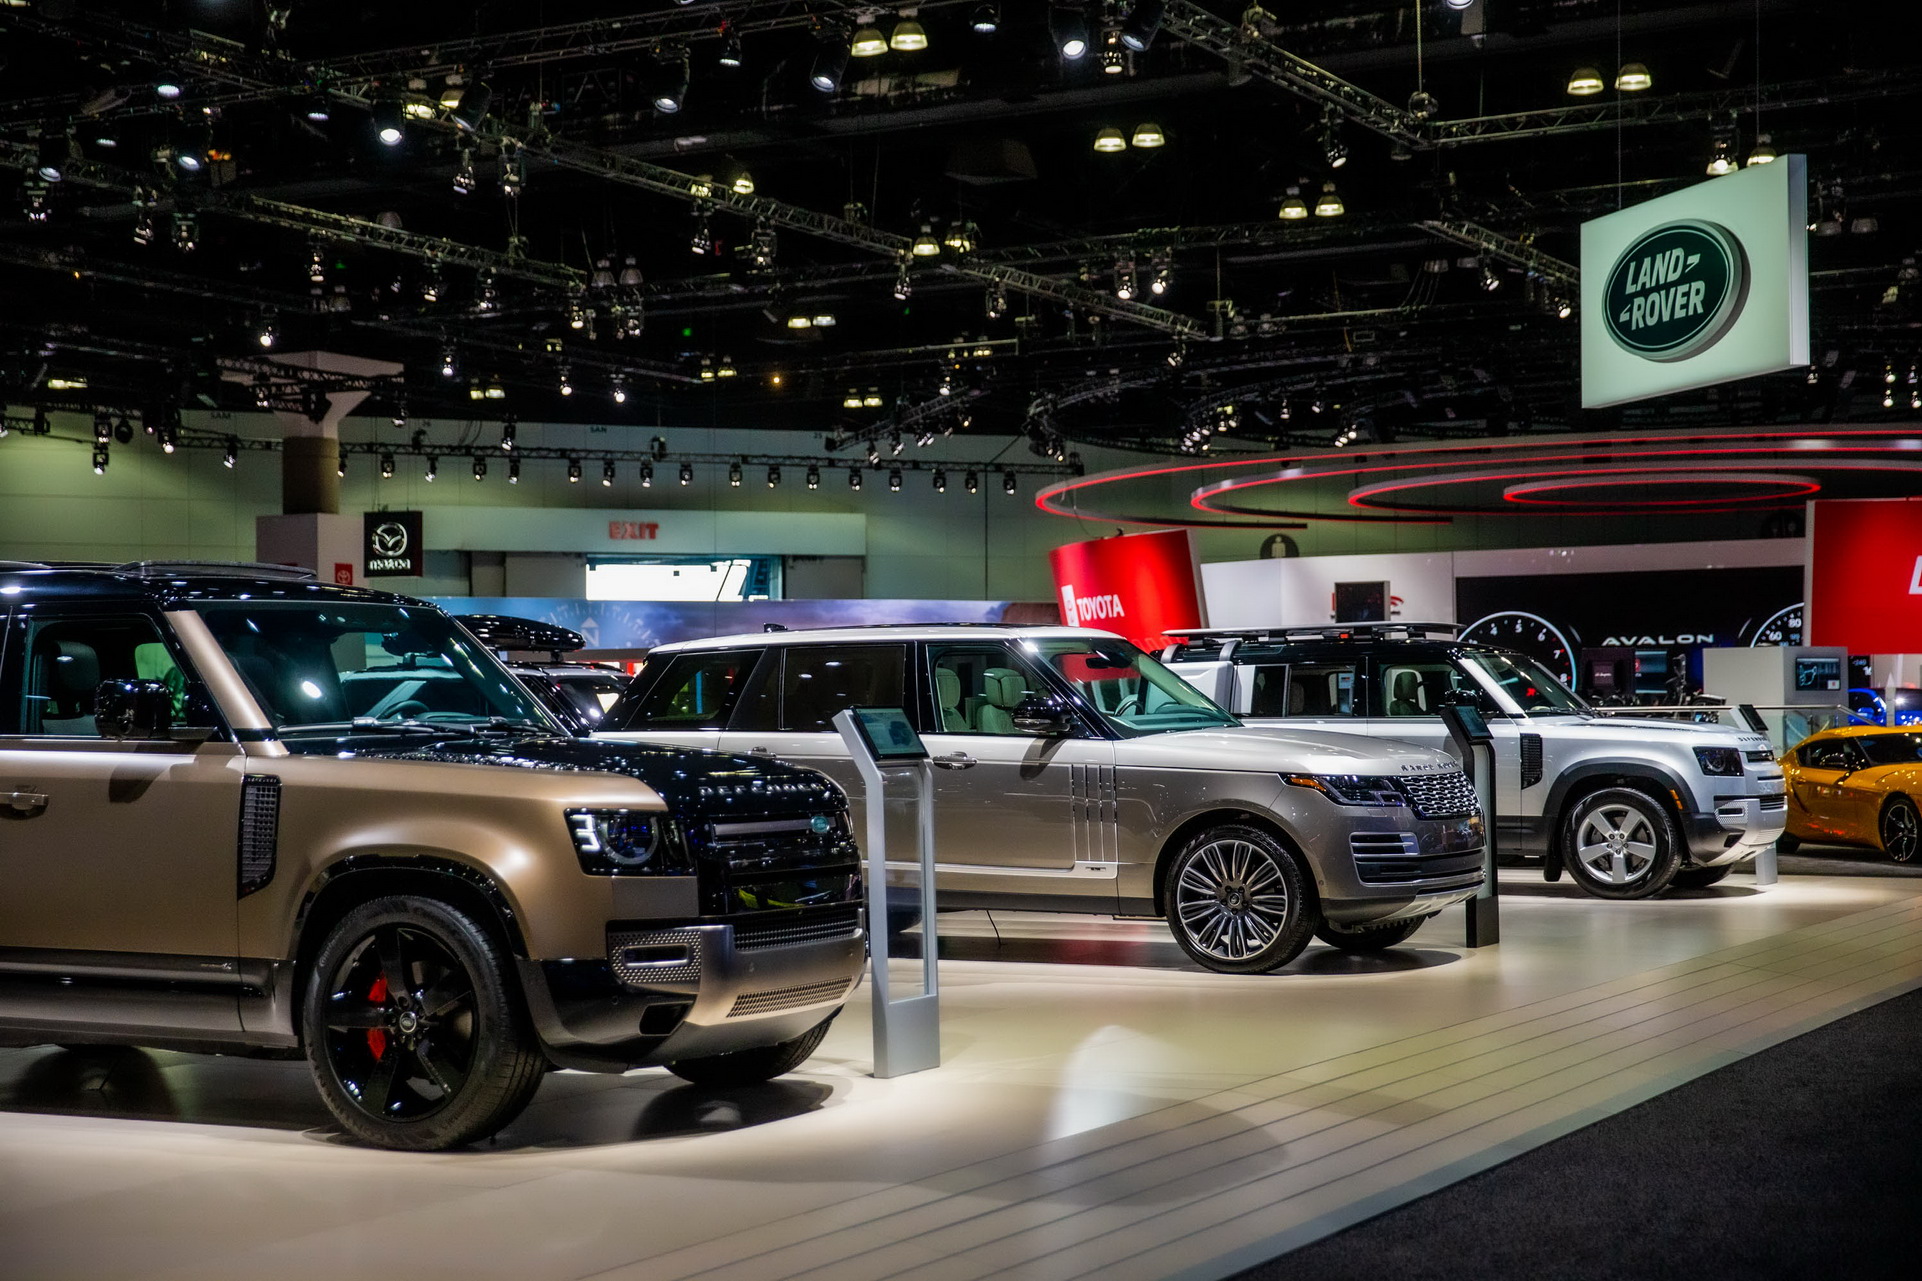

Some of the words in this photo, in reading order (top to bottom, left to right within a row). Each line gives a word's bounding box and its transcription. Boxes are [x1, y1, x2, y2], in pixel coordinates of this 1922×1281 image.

[1625, 247, 1685, 295] LAND
[1631, 280, 1706, 331] ROVER
[608, 521, 660, 540] EXIT
[1076, 594, 1125, 621] TOYOTA
[1788, 618, 1802, 628] 80
[1490, 627, 1498, 636] 4
[1537, 632, 1546, 642] 6
[1768, 631, 1783, 642] 60
[1601, 634, 1714, 646] AVALON
[1553, 650, 1560, 659] 7
[1560, 673, 1568, 683] 8
[699, 783, 825, 796] DEFENDER
